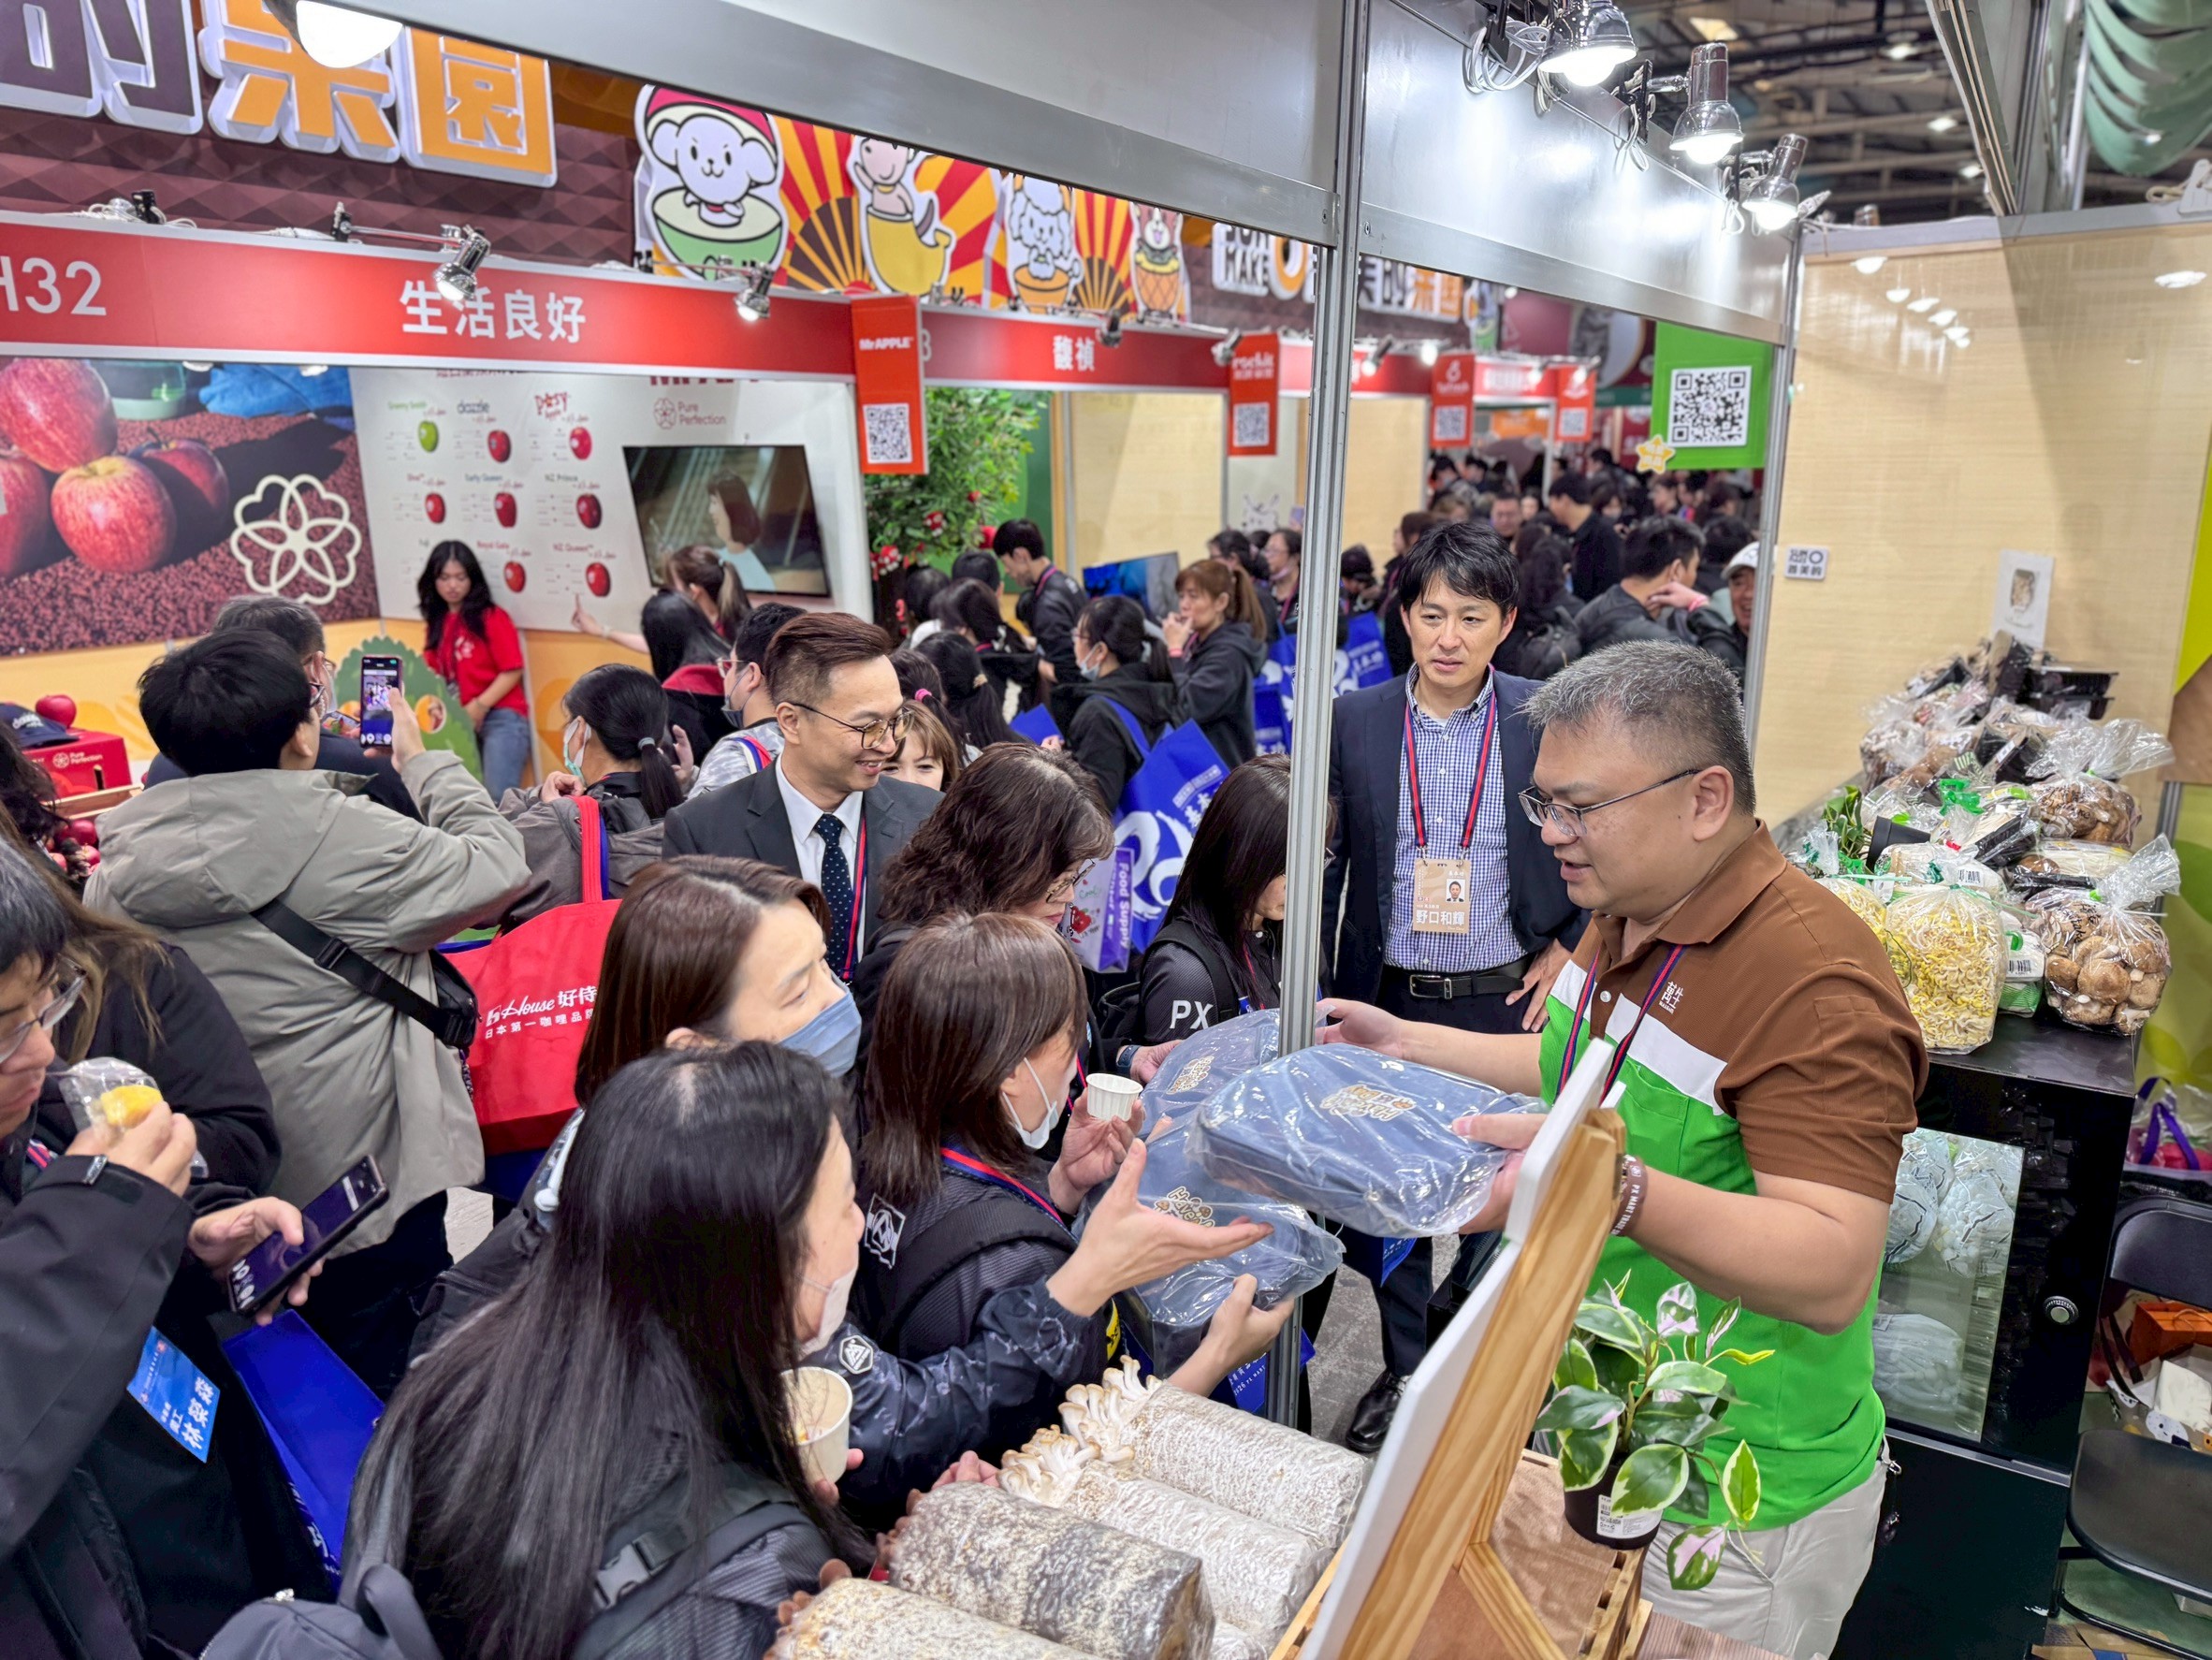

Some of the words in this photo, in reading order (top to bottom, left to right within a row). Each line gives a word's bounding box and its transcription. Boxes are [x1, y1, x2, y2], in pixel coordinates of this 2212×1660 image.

[400, 279, 586, 343] 生活良好
[457, 400, 490, 414] dazzle
[678, 401, 699, 414] Pure
[678, 414, 726, 426] Perfection
[1118, 863, 1130, 897] Food
[1119, 900, 1131, 950] Supply
[1416, 910, 1465, 926] 野口和輝
[502, 995, 556, 1019] House
[558, 985, 598, 1009] 好侍
[1170, 998, 1215, 1031] PX
